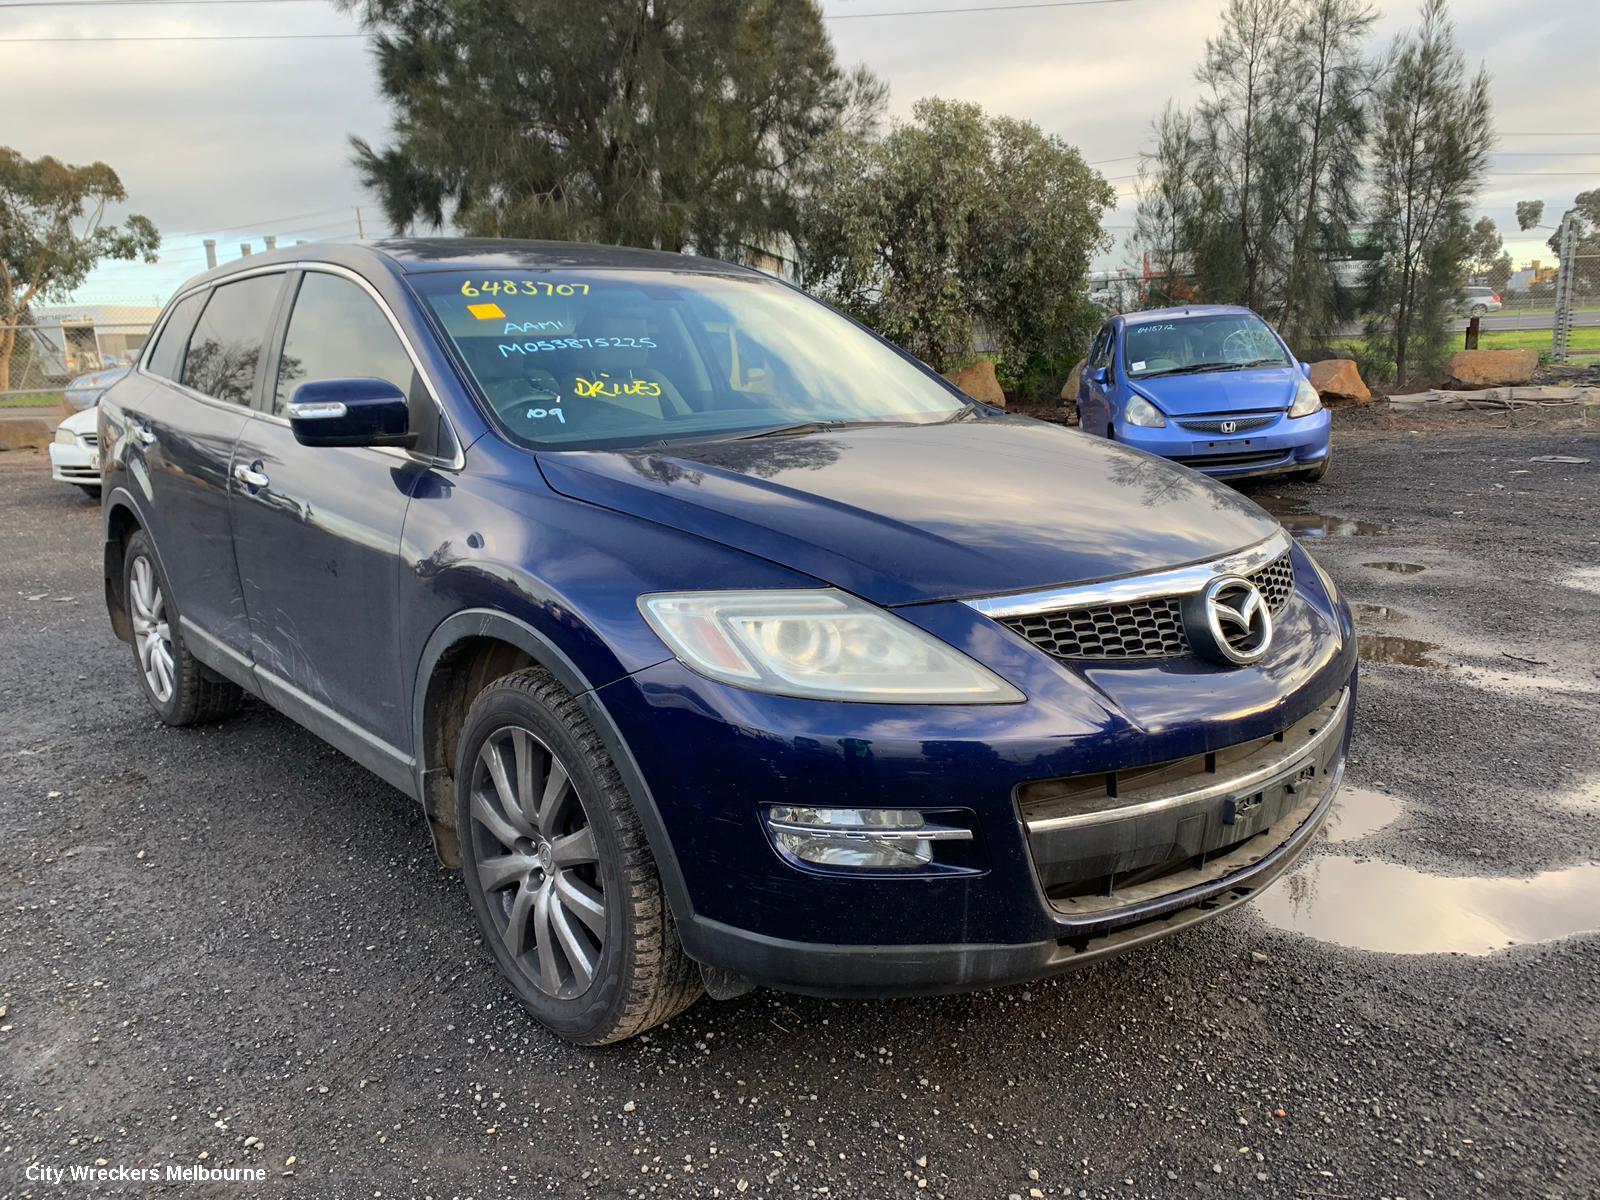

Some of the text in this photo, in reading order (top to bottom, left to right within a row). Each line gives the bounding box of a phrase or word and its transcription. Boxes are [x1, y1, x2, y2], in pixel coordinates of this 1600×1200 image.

[461, 280, 590, 297] 6483707
[503, 320, 564, 335] AAMI
[498, 337, 657, 358] M053875225
[526, 408, 566, 423] 109
